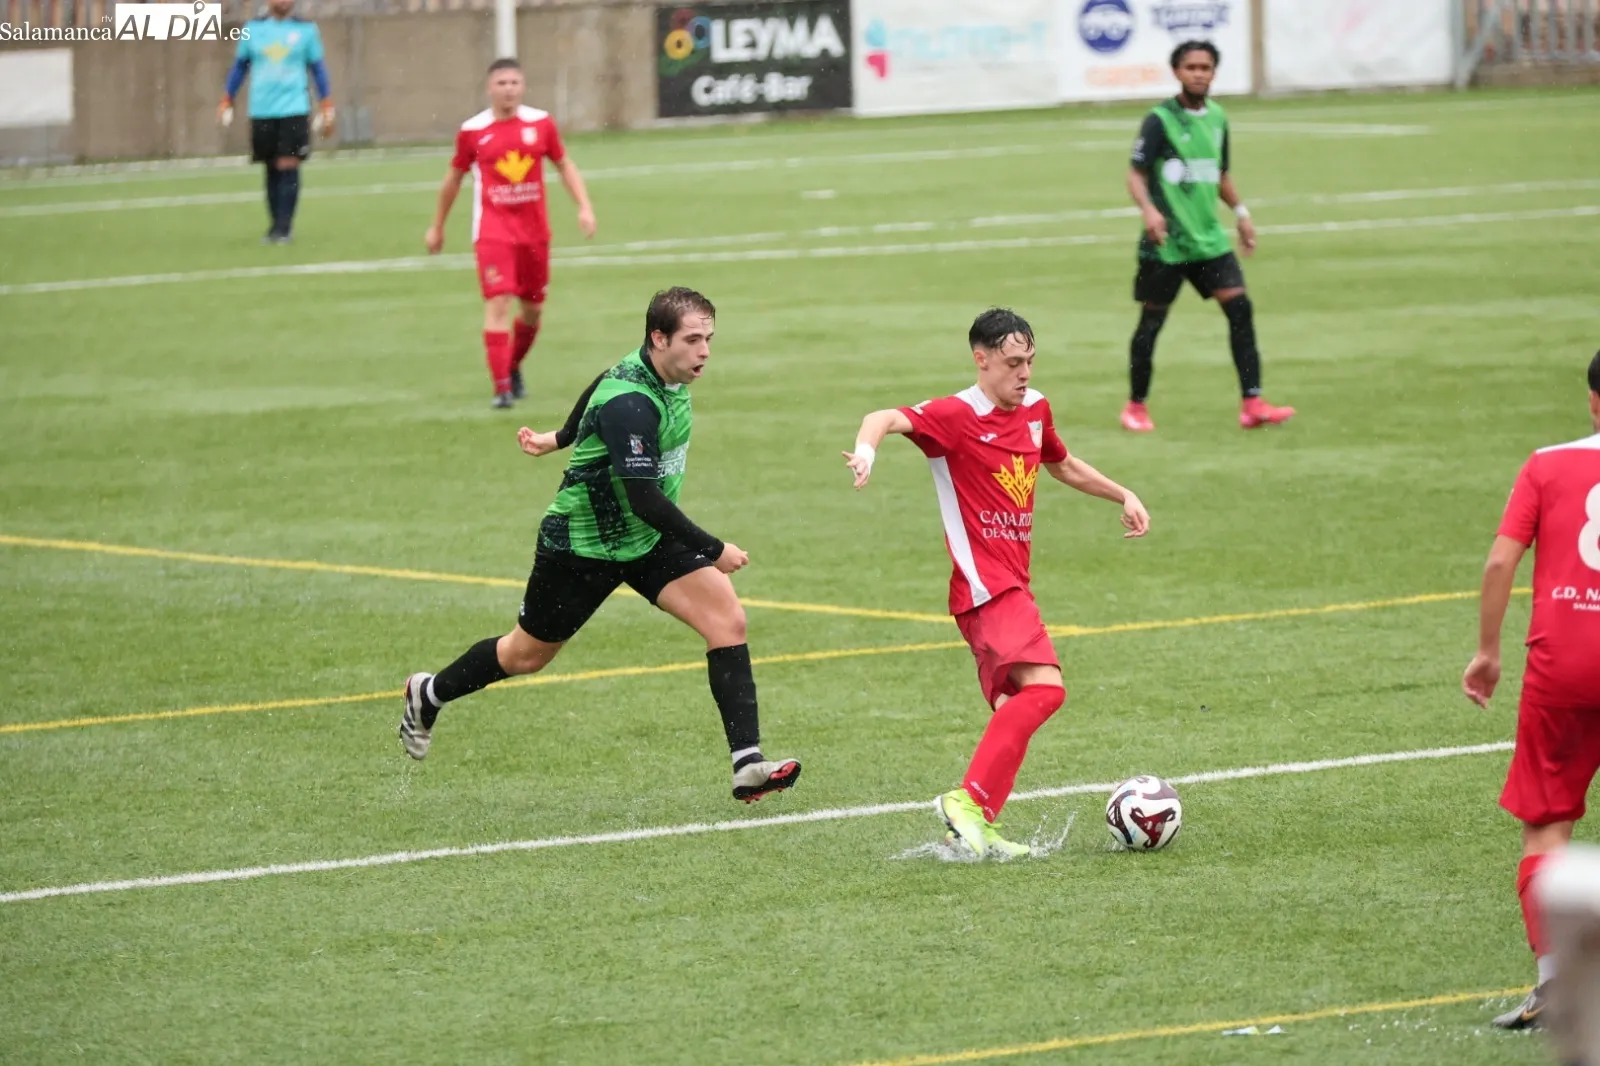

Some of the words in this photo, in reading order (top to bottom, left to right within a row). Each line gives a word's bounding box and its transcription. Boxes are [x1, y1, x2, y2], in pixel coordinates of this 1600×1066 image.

[710, 14, 846, 63] LEYMA
[979, 510, 1017, 528] CAJA
[1585, 586, 1600, 602] N
